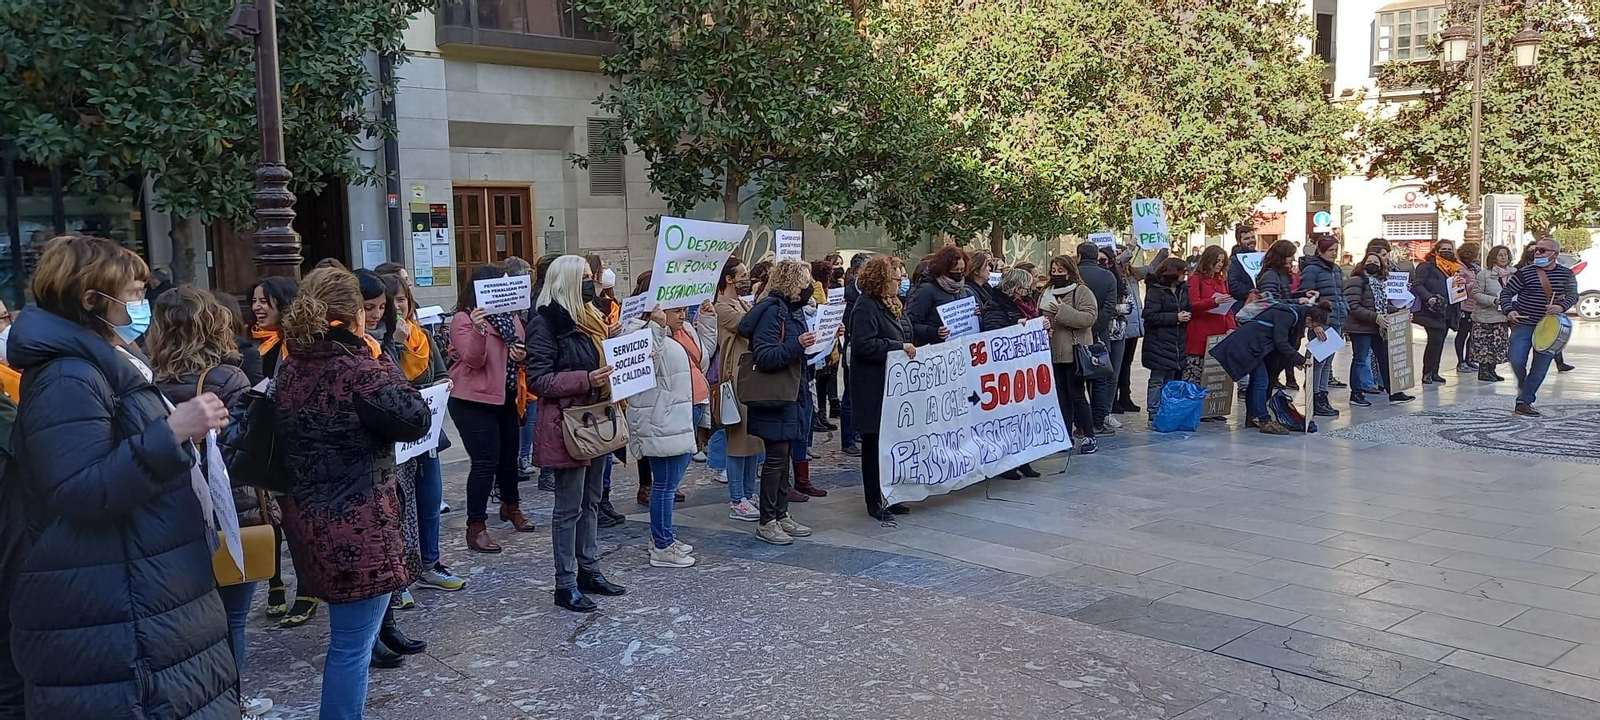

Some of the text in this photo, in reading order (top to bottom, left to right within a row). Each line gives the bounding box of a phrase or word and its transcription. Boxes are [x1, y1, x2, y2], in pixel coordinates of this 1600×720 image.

[548, 216, 555, 227] 2
[687, 236, 739, 252] DESPIDOS
[666, 260, 718, 274] EN ZONAS
[613, 338, 648, 357] SERVICIOS
[615, 353, 645, 371] SOCIALES
[887, 354, 948, 397] AGOSTO
[948, 347, 966, 381] 22
[970, 340, 988, 366] 56
[612, 366, 651, 386] DE CALIDAD
[898, 363, 1052, 428] A LA CALLE 50.000
[891, 428, 976, 486] PERSONAS
